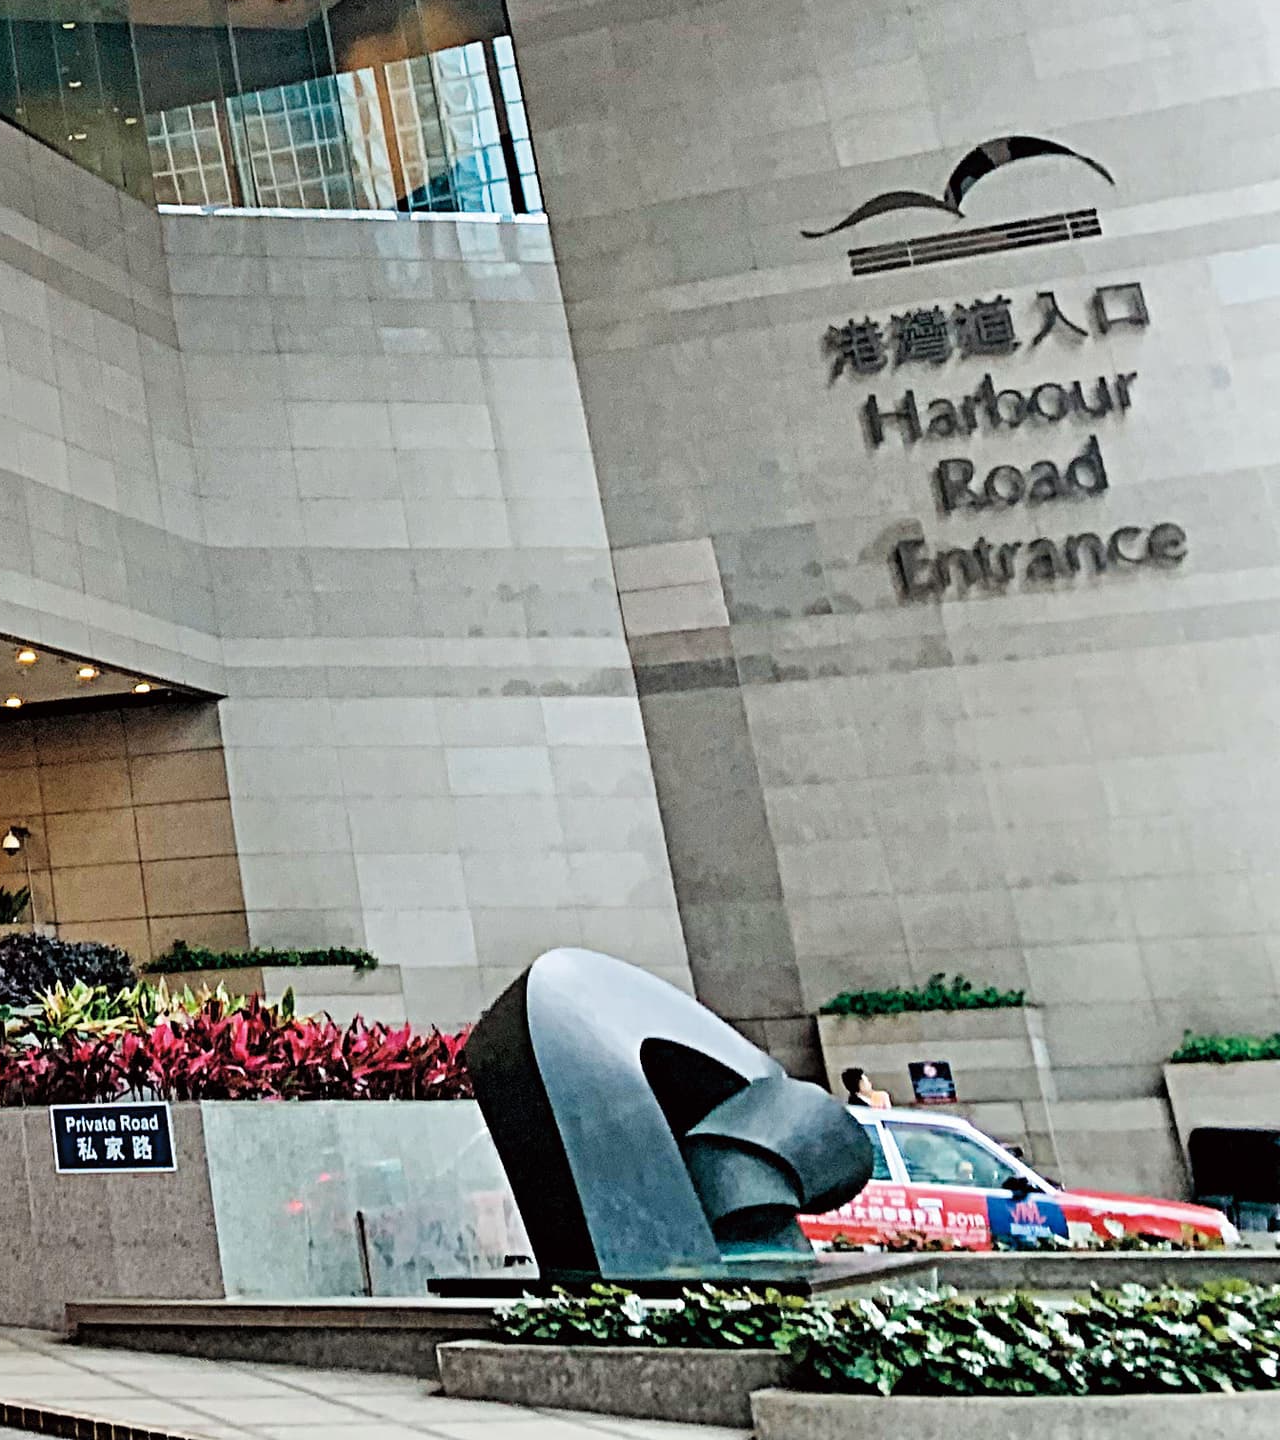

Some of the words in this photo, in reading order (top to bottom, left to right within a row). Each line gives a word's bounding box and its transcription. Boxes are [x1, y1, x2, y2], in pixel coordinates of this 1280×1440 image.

[825, 281, 1150, 388] 港灣道入口
[859, 372, 1138, 449] Harbour
[933, 433, 1109, 516] Road
[889, 521, 1188, 600] Entrance
[65, 1115, 116, 1134] Private
[119, 1113, 159, 1132] Road
[76, 1134, 153, 1162] 私家路
